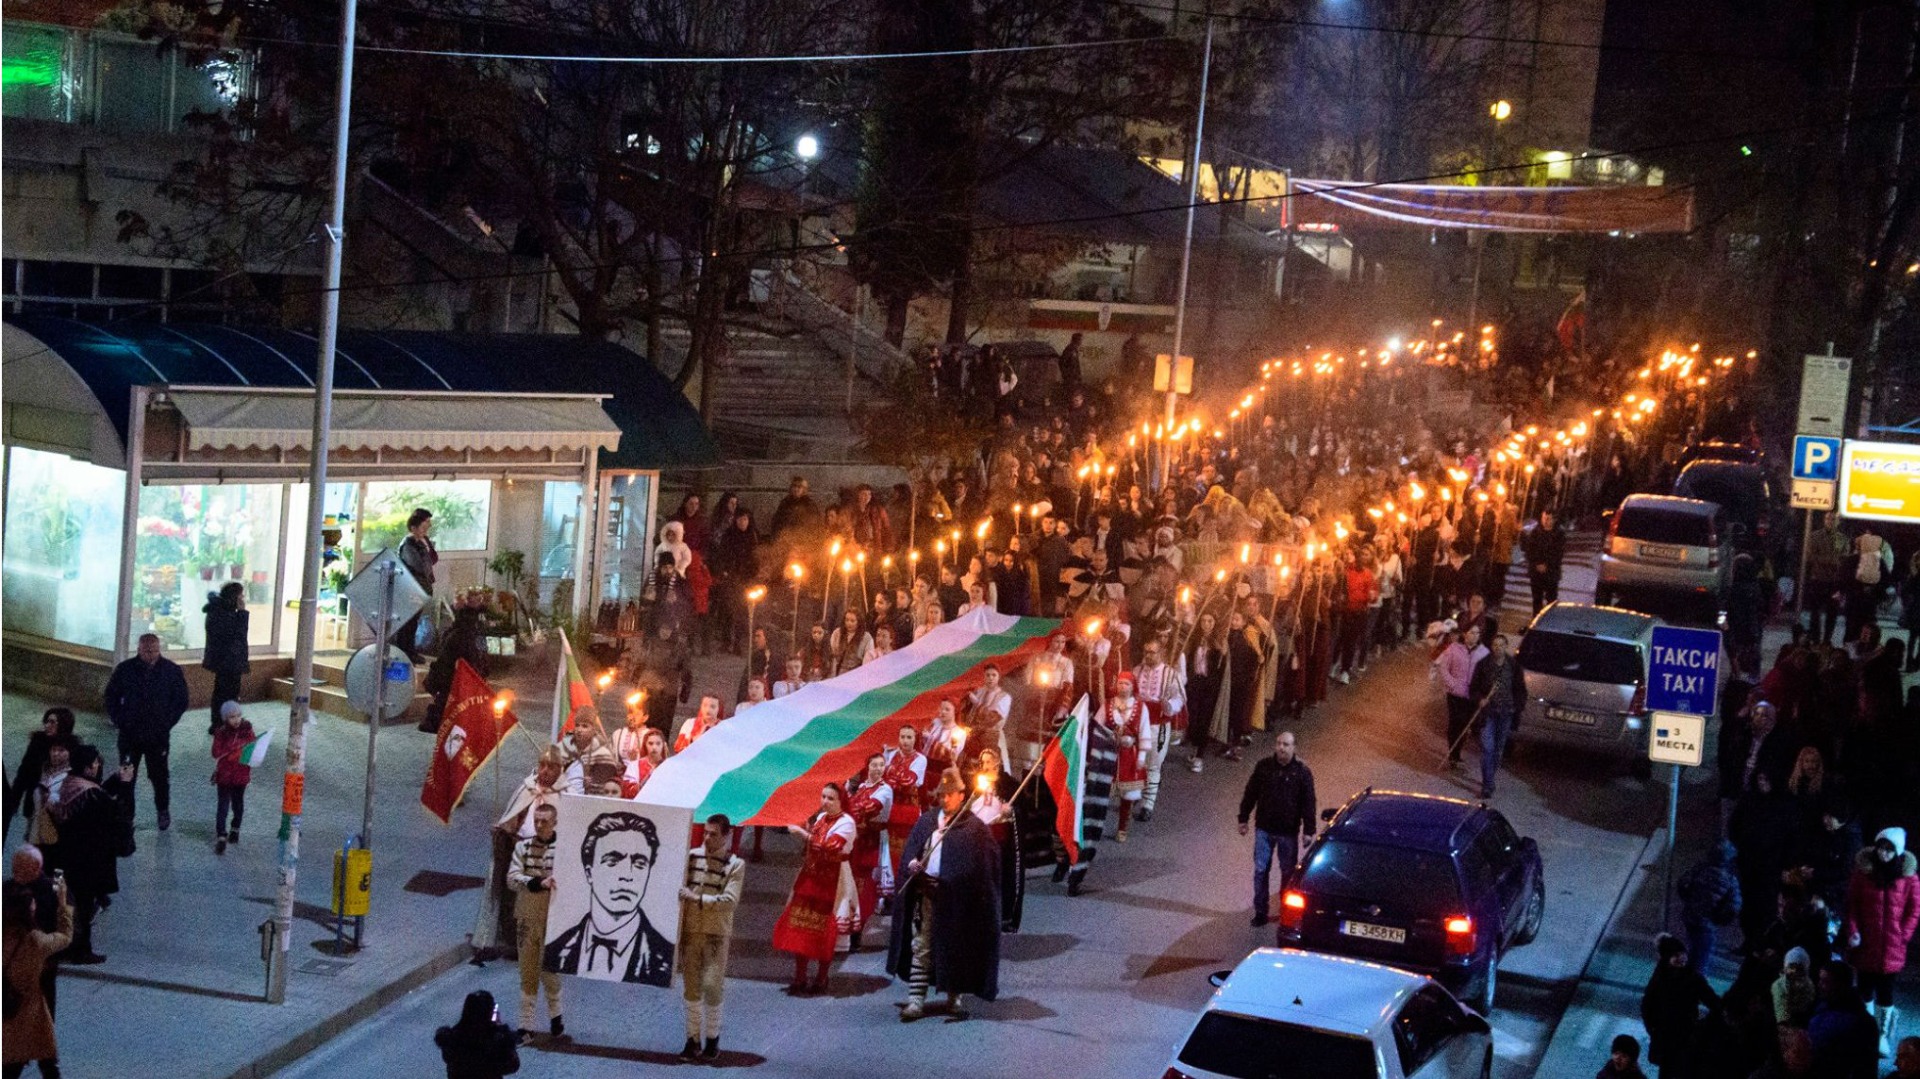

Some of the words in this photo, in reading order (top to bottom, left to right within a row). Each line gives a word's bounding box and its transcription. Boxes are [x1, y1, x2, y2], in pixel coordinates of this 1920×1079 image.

[1805, 442, 1831, 474] P
[1653, 646, 1717, 670] ТАКСИ
[1662, 673, 1705, 695] TAXI
[1673, 728, 1681, 736] 3
[1657, 740, 1695, 751] МЕСТА
[1350, 922, 1358, 934] E
